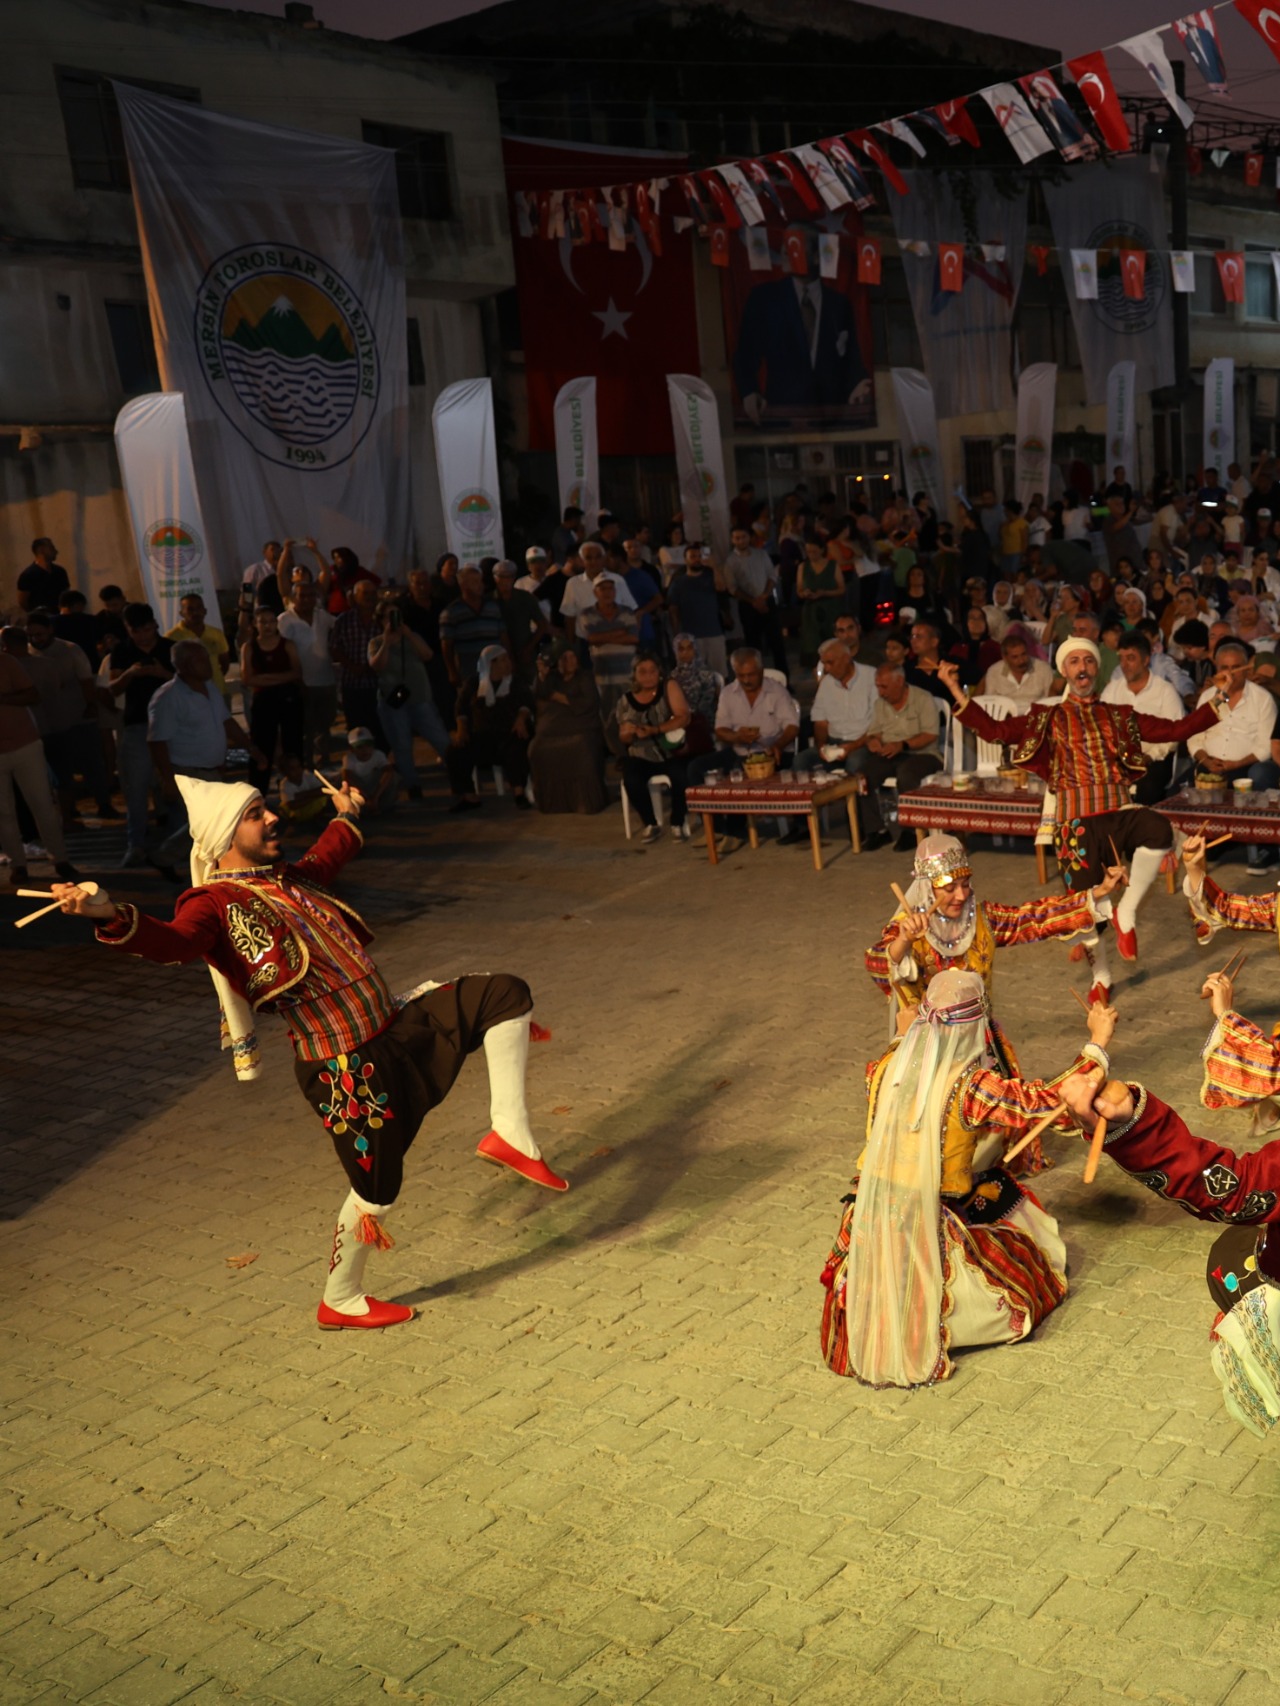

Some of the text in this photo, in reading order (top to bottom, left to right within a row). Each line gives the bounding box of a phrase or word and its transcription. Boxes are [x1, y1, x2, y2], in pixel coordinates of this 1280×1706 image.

[202, 251, 376, 399] MERSİN TOROSLAR BELEDİYESİ
[285, 447, 326, 464] 1994
